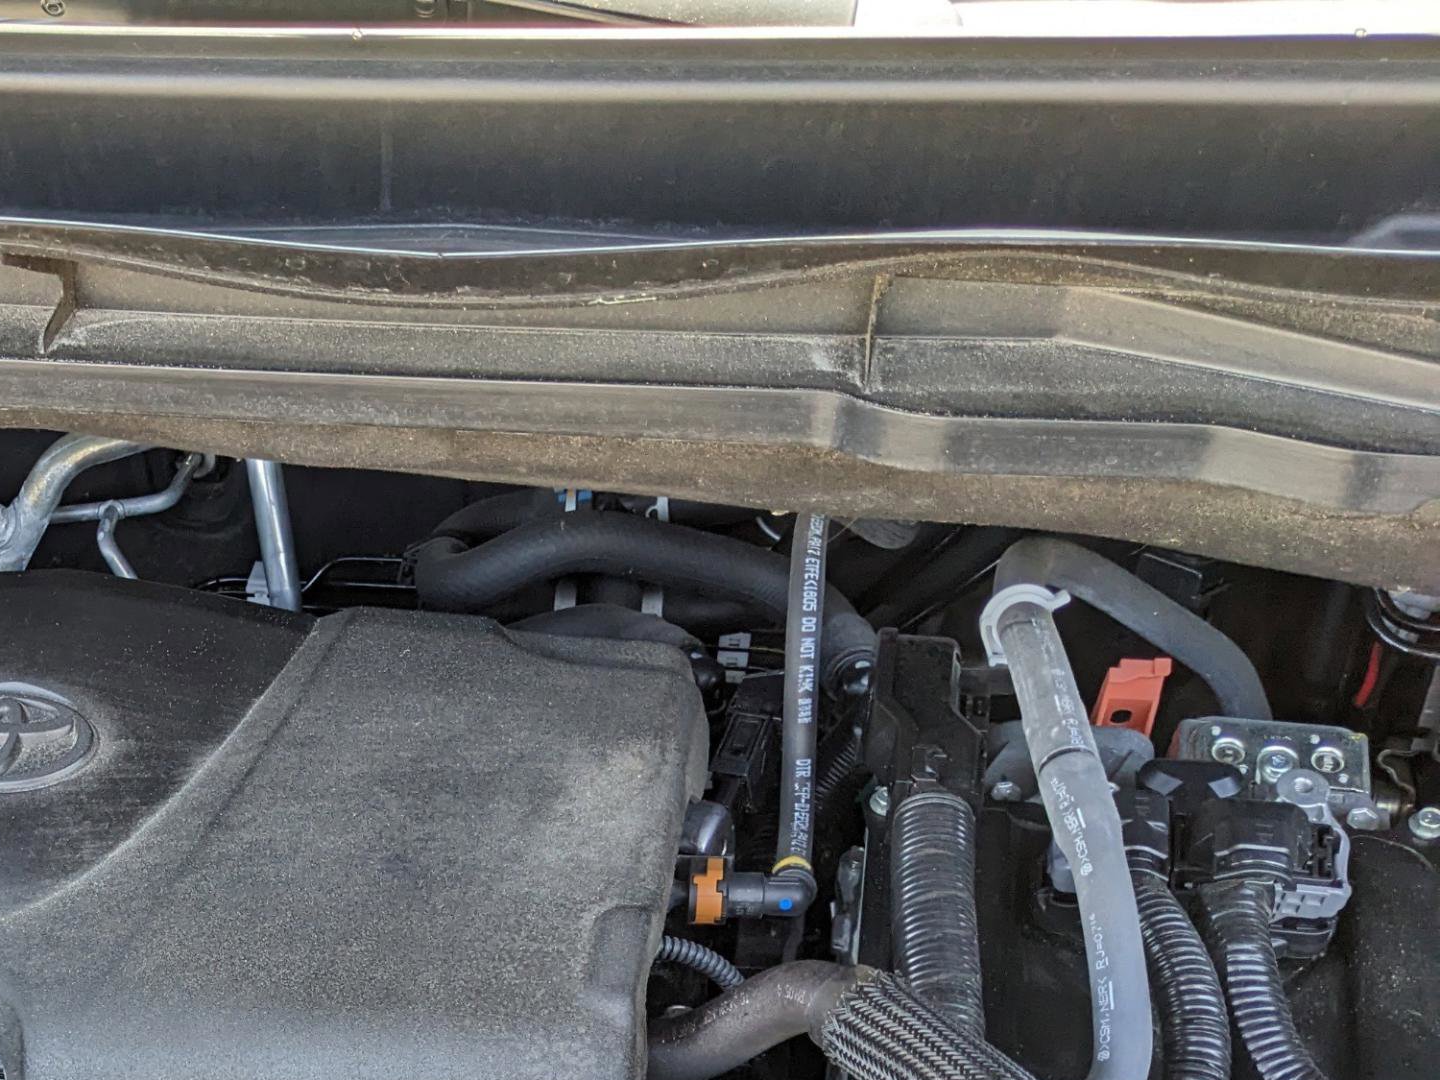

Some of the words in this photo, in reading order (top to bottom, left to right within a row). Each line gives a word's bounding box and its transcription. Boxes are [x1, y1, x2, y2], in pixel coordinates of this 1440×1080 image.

[801, 616, 816, 632] DO
[798, 637, 815, 659] NOT
[794, 758, 810, 777] DTR
